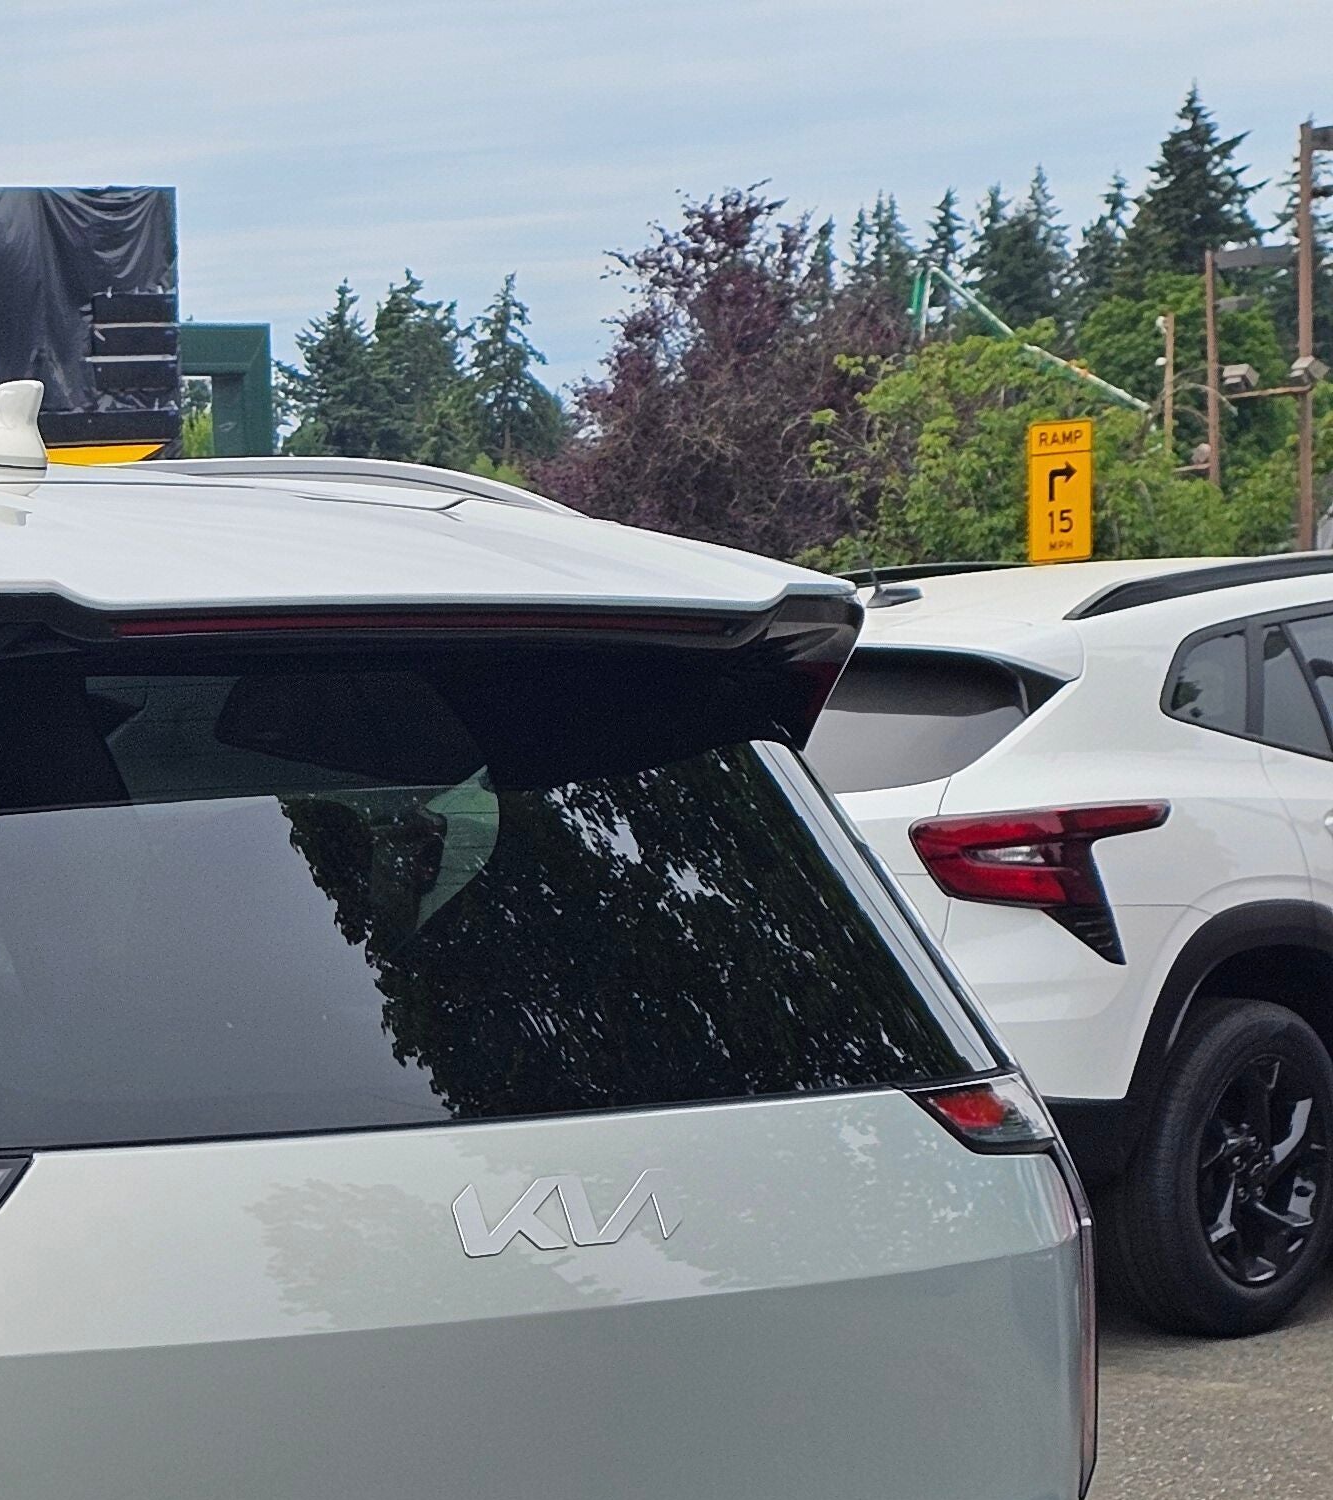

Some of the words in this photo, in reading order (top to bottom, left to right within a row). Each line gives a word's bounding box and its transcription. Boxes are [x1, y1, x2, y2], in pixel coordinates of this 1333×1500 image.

[1038, 429, 1083, 447] RAMP
[1048, 508, 1074, 535] 15
[1048, 540, 1074, 552] MPH
[450, 1167, 685, 1259] KIA
